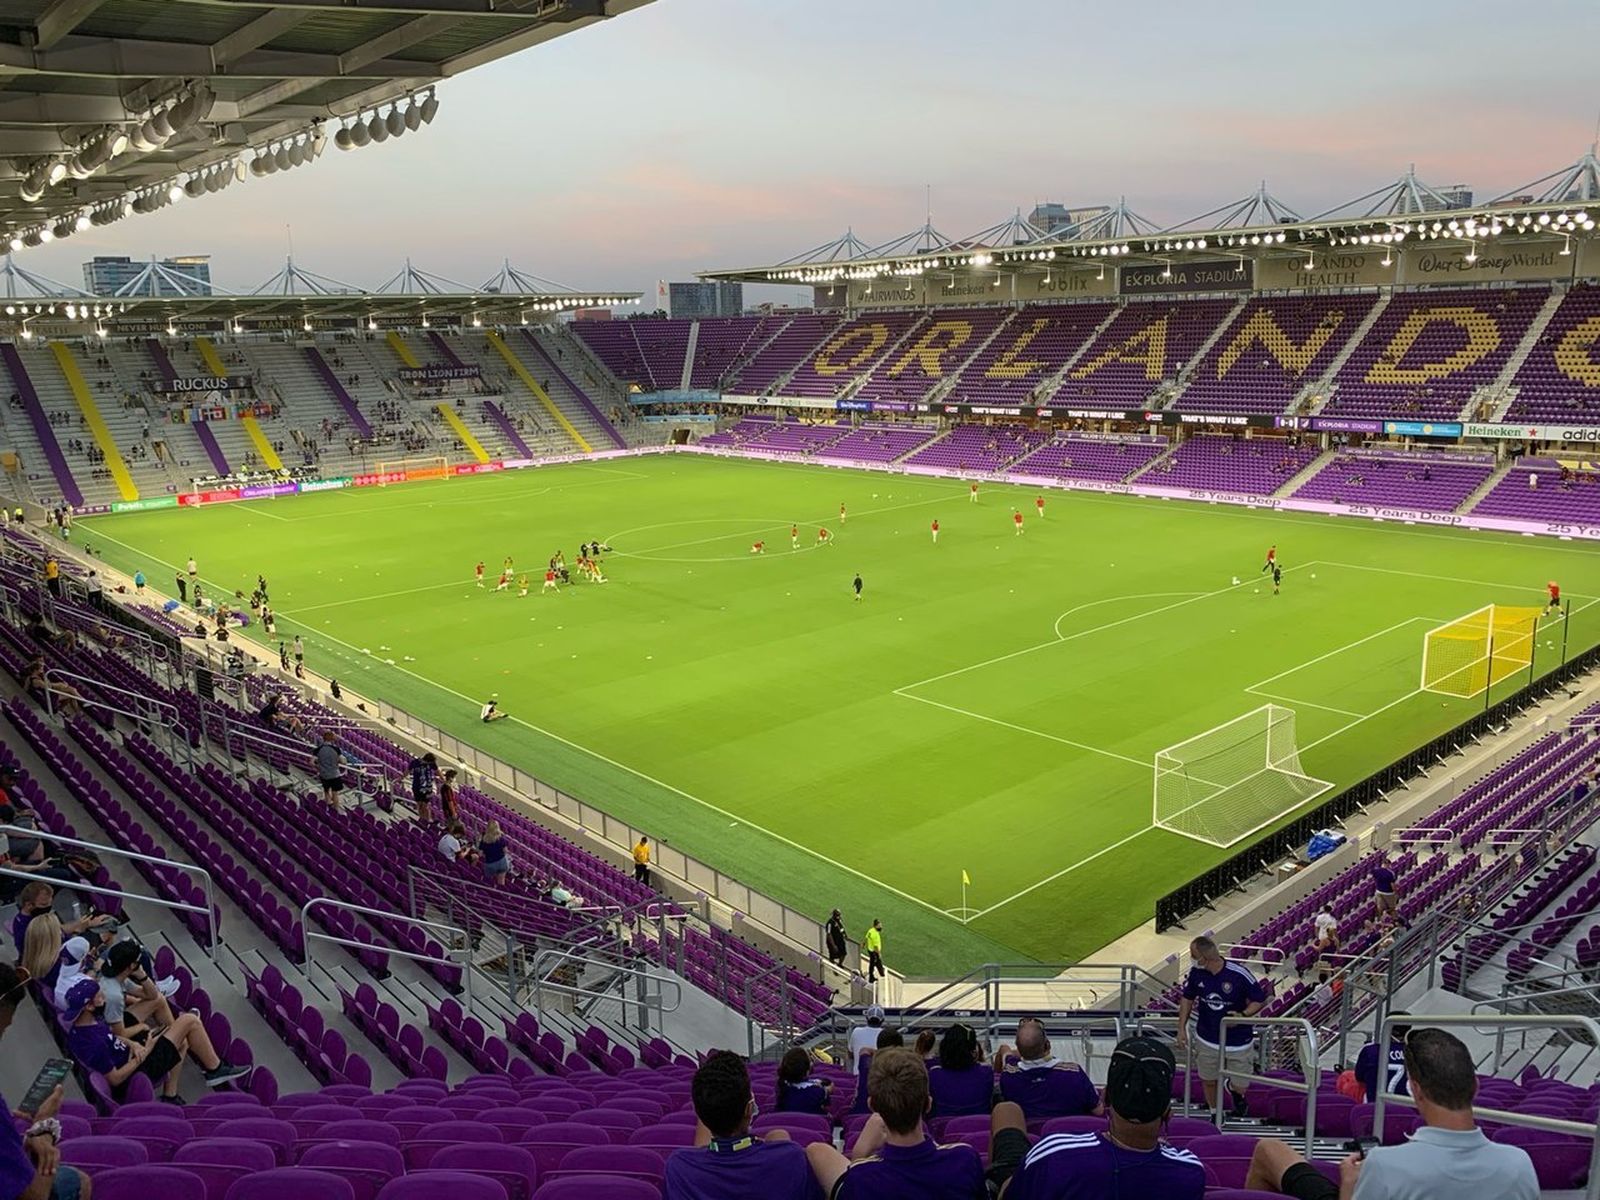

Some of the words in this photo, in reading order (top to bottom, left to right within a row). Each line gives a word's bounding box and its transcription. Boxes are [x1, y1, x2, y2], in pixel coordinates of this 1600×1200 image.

[1288, 256, 1366, 271] ORLANDO
[1126, 271, 1187, 287] EXPLORIA
[1194, 269, 1247, 283] STADIUM
[1296, 272, 1355, 286] HEALTH
[942, 285, 985, 297] Heineken
[401, 370, 426, 379] IRON
[428, 369, 453, 379] LION
[454, 367, 479, 377] FIRM
[173, 377, 228, 391] RUCKUS
[1068, 410, 1088, 418] THAT'S
[1181, 414, 1206, 423] THAT'S
[1206, 416, 1227, 424] WHAT
[1232, 417, 1248, 425] LIKE
[1351, 422, 1377, 430] STADIUM
[1468, 427, 1522, 437] Heineken
[1072, 480, 1102, 489] Years
[1105, 483, 1134, 494] Deep
[1189, 490, 1206, 498] 25
[1210, 491, 1245, 502] Years
[1247, 495, 1282, 507] Deep
[1348, 505, 1369, 514] 25
[1373, 507, 1417, 519] Years
[1420, 511, 1462, 526] Deep
[1546, 523, 1571, 534] 25
[1387, 1063, 1406, 1095] 7
